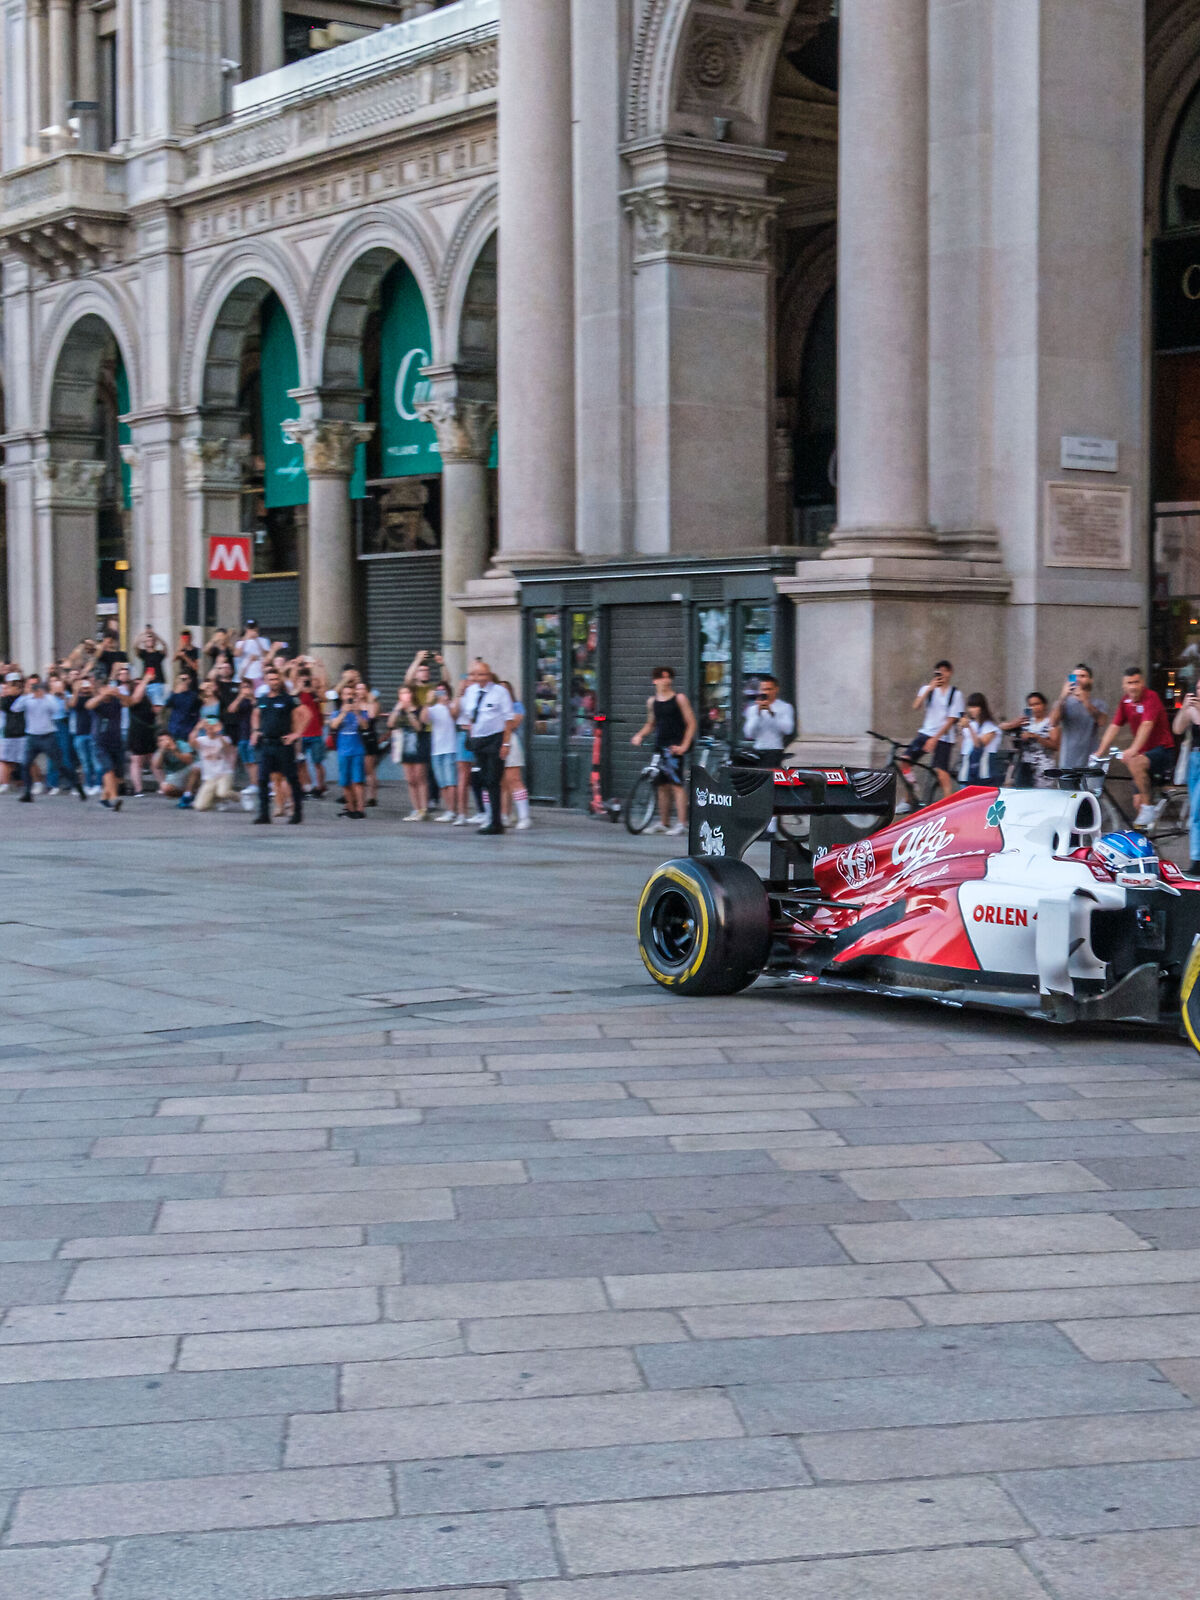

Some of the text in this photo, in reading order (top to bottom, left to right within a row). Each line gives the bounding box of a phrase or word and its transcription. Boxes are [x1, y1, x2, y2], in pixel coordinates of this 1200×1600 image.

[210, 544, 249, 571] M
[709, 793, 732, 806] FLOKI
[973, 904, 1028, 927] ORLEN
